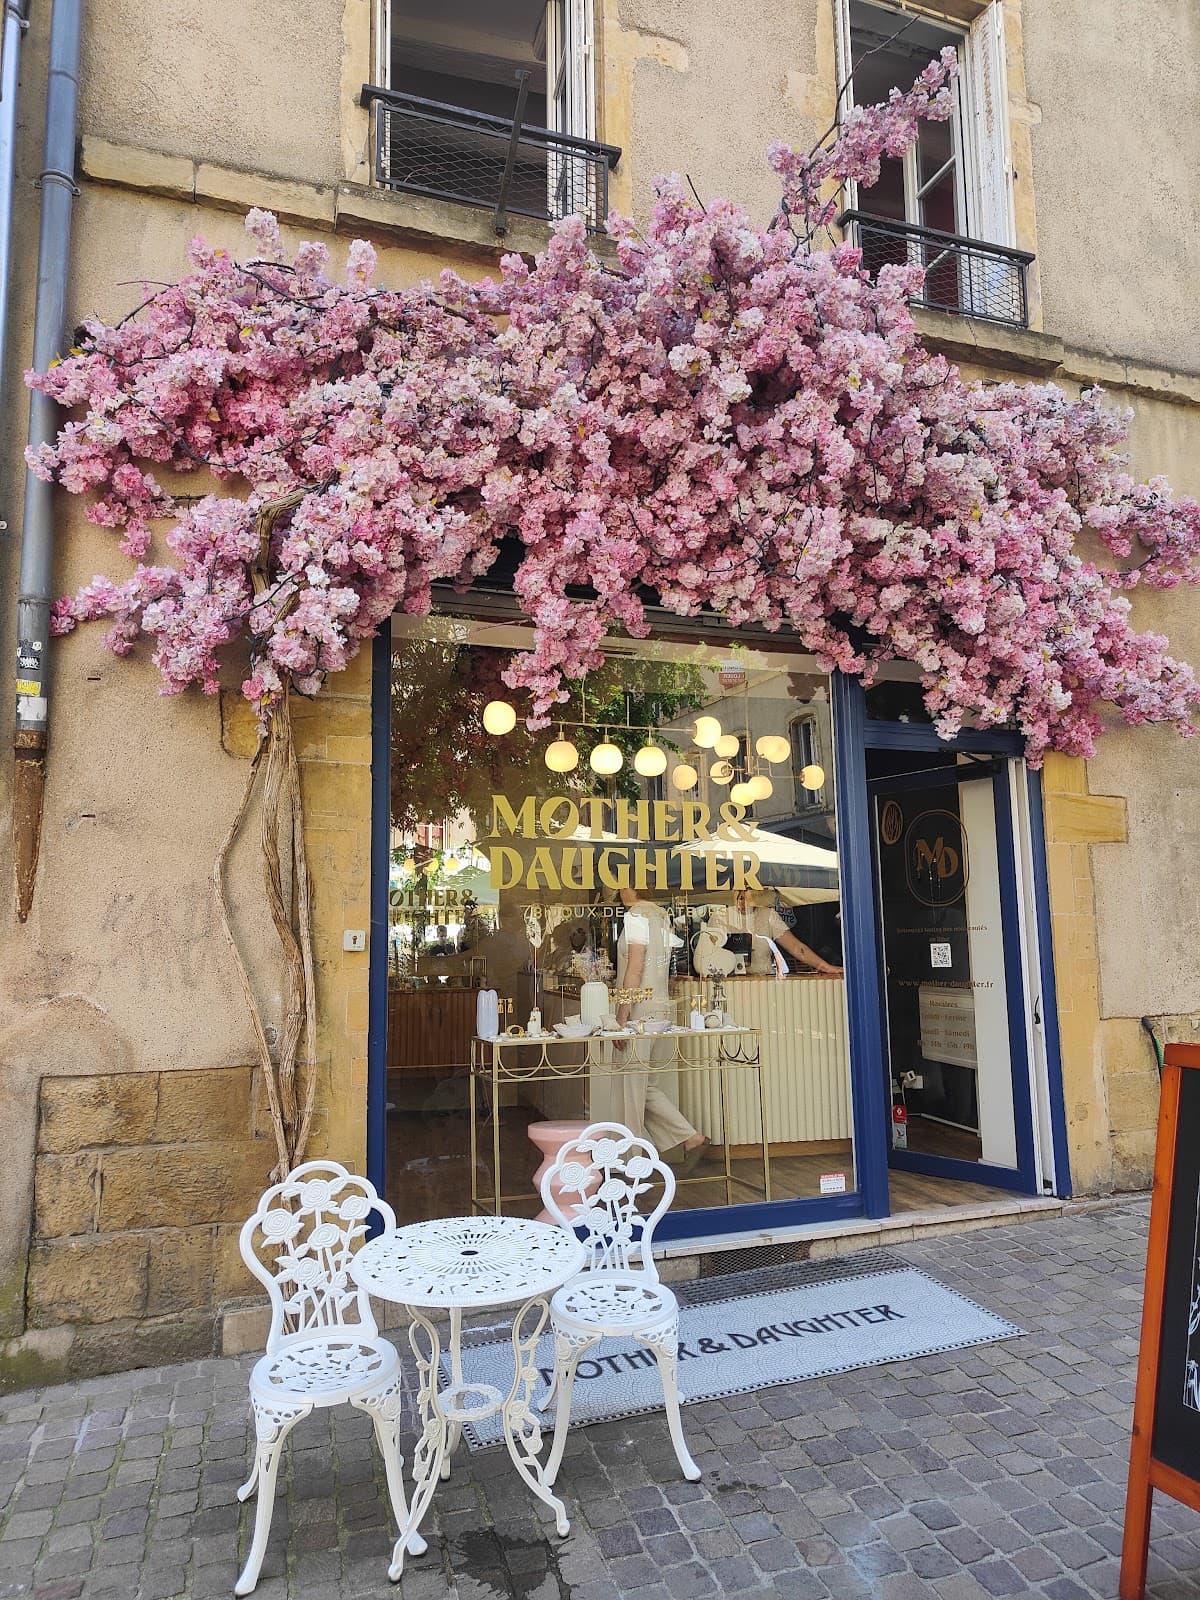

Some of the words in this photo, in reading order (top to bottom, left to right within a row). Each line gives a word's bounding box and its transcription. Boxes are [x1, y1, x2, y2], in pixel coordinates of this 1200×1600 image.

[488, 846, 764, 891] DAUGHTER
[914, 837, 959, 878] MD
[603, 905, 626, 919] DE
[728, 1304, 905, 1349] DAUGHTER
